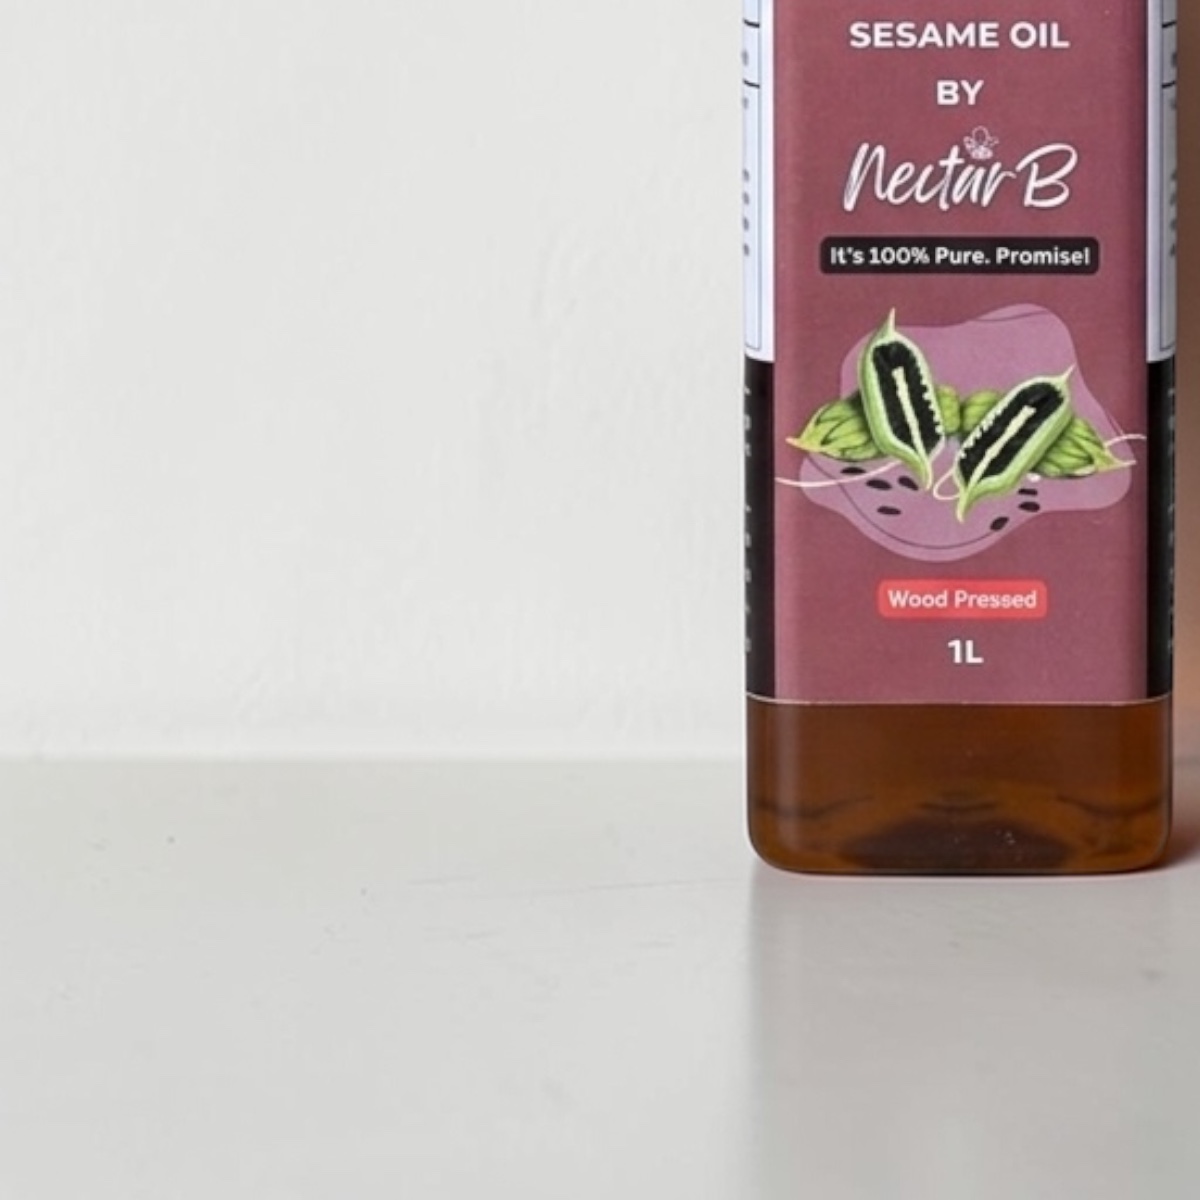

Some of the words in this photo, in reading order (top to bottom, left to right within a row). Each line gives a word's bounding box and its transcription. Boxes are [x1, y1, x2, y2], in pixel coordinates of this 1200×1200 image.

[849, 21, 1000, 49] SESAME
[1009, 21, 1070, 49] OIL
[936, 79, 984, 106] BY
[830, 246, 865, 265] It's
[869, 246, 931, 265] 100%
[934, 246, 991, 265] Pure.
[887, 589, 948, 609] Wood
[954, 589, 1037, 609] Pressed
[947, 639, 984, 664] 1L
